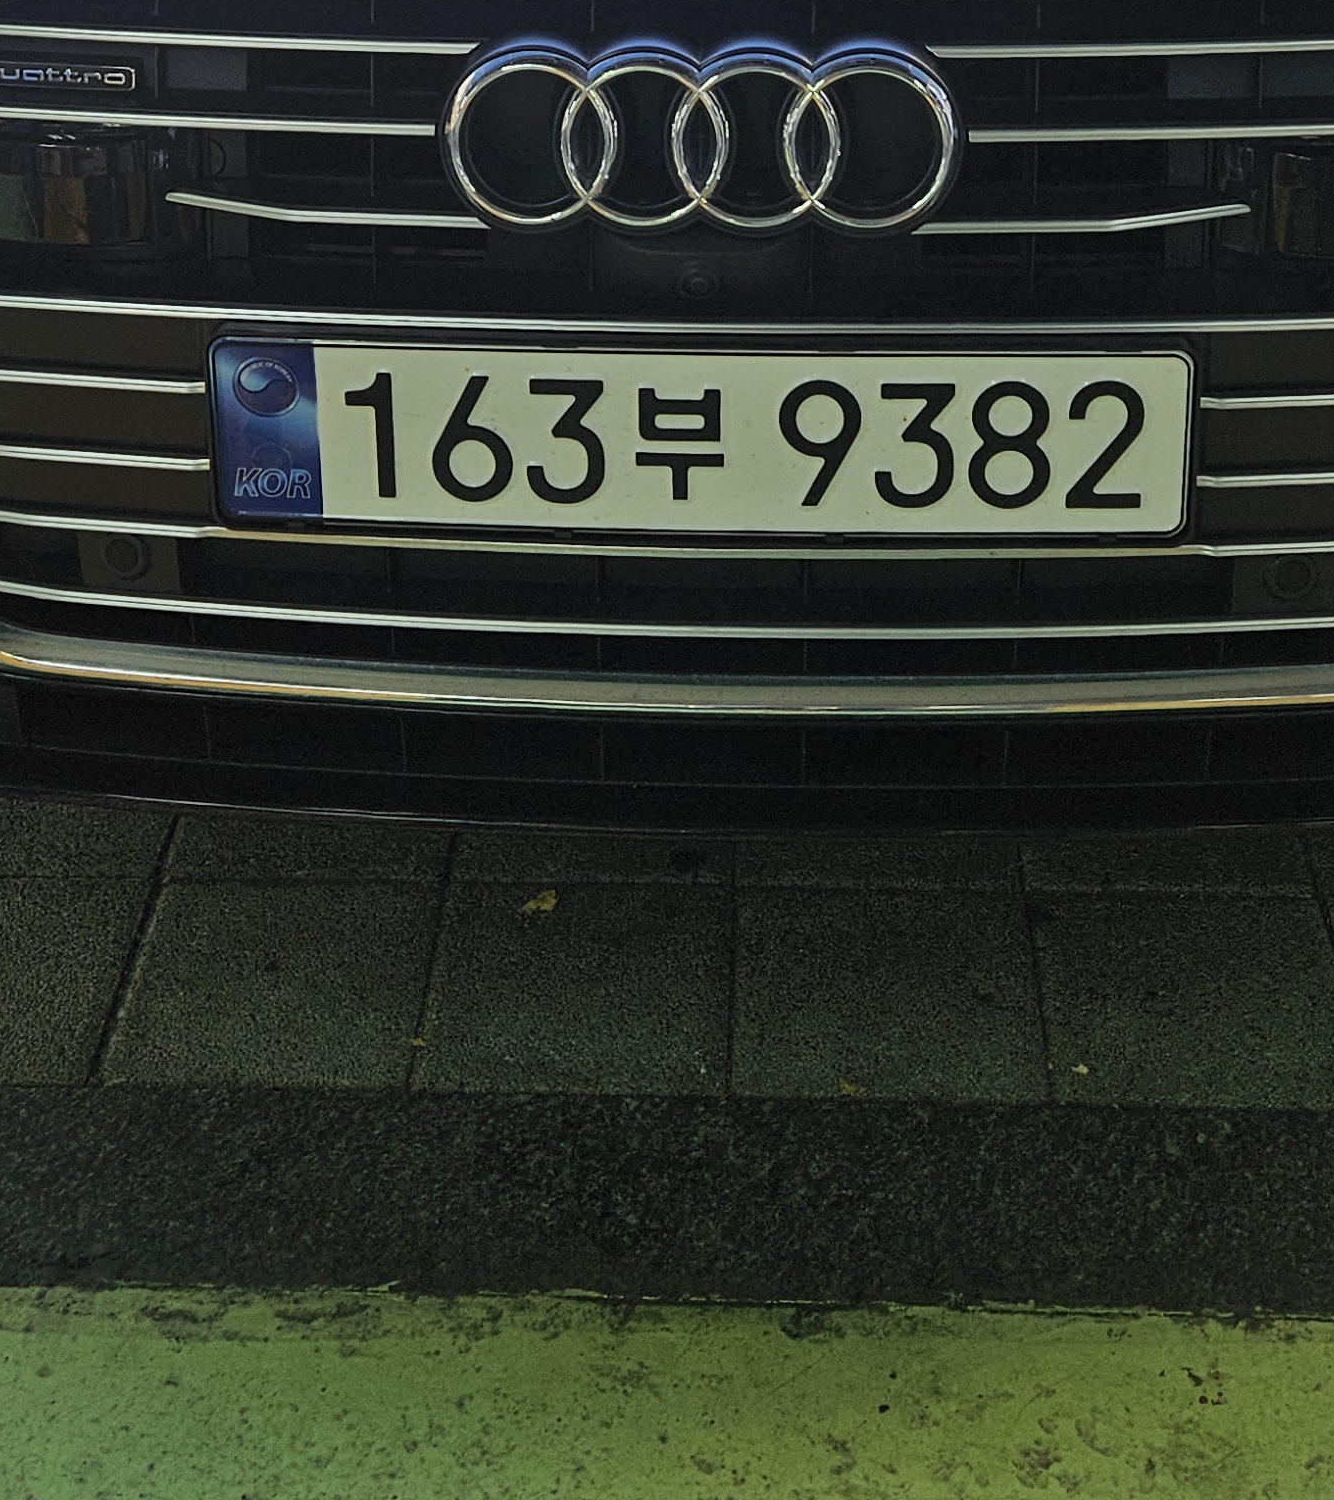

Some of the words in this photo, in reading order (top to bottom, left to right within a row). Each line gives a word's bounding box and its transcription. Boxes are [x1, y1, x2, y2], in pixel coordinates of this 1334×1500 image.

[344, 372, 725, 504] 163부
[778, 380, 1145, 509] 9382
[234, 467, 312, 499] KOR
